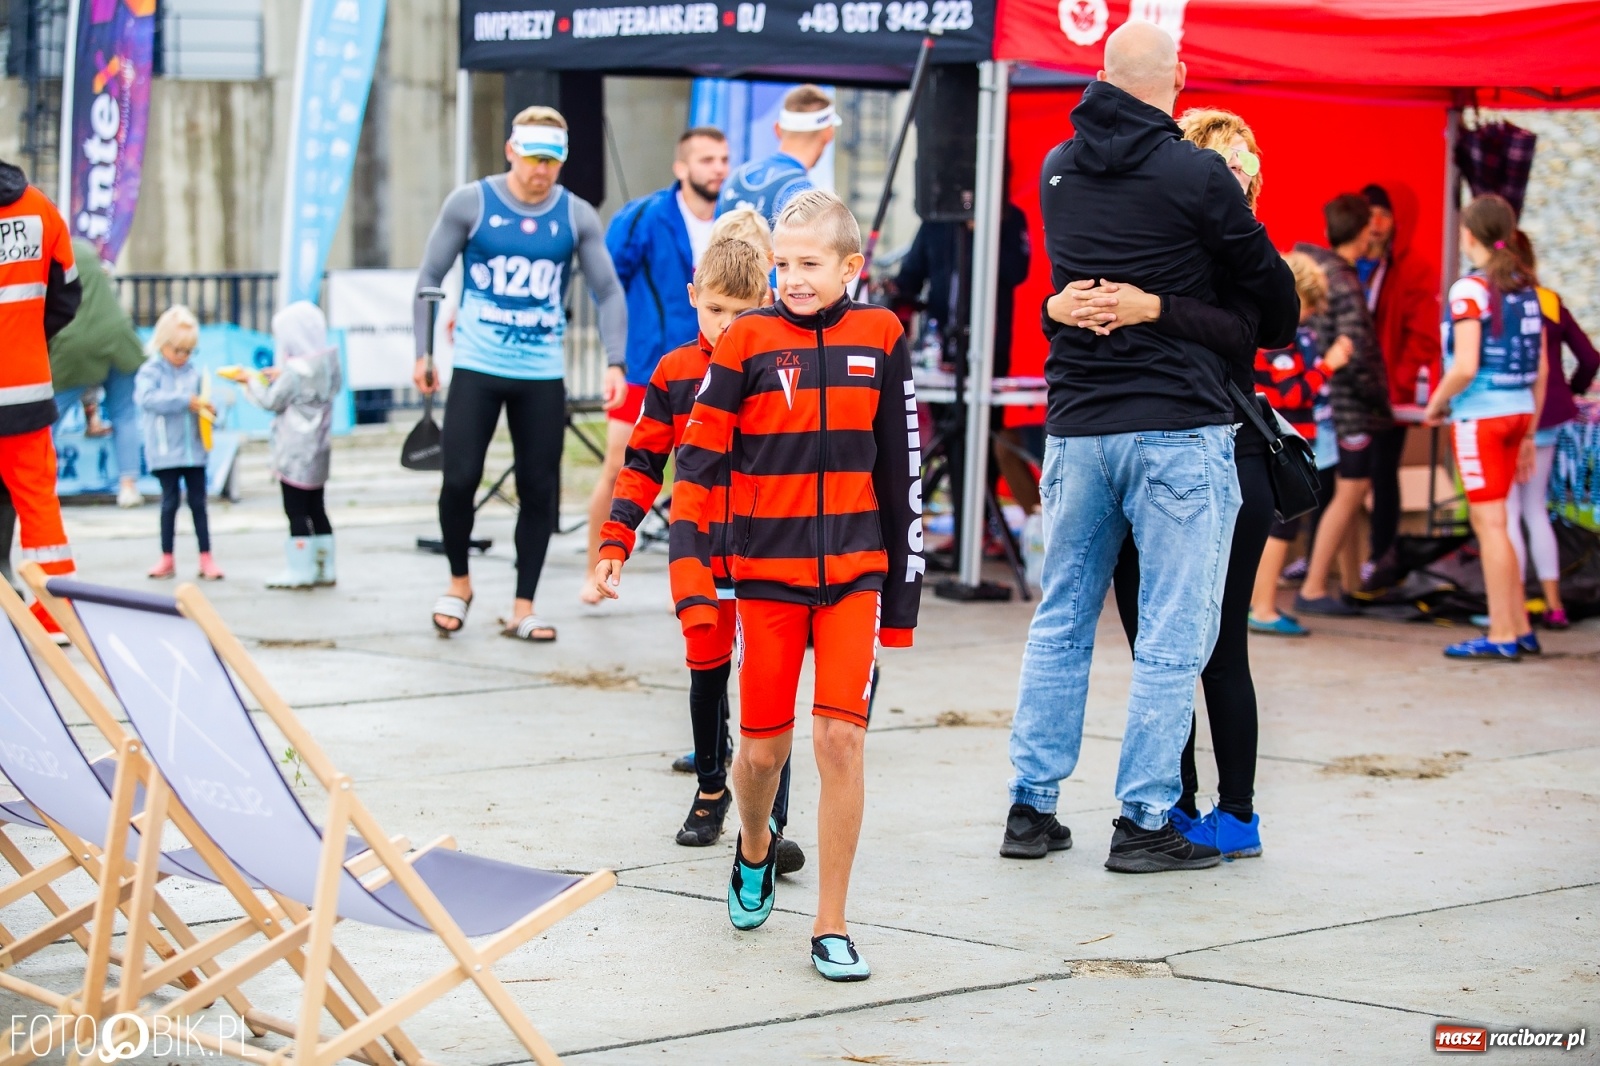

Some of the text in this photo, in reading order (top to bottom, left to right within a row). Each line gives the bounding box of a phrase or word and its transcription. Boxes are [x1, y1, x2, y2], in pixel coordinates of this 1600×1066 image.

[474, 10, 555, 41] IMPREZY
[573, 3, 718, 38] KONFERANSJER
[737, 2, 766, 33] DJ
[886, 1, 929, 32] 342
[932, 0, 974, 31] 223
[1049, 175, 1062, 187] 4F
[776, 351, 800, 367] PZK
